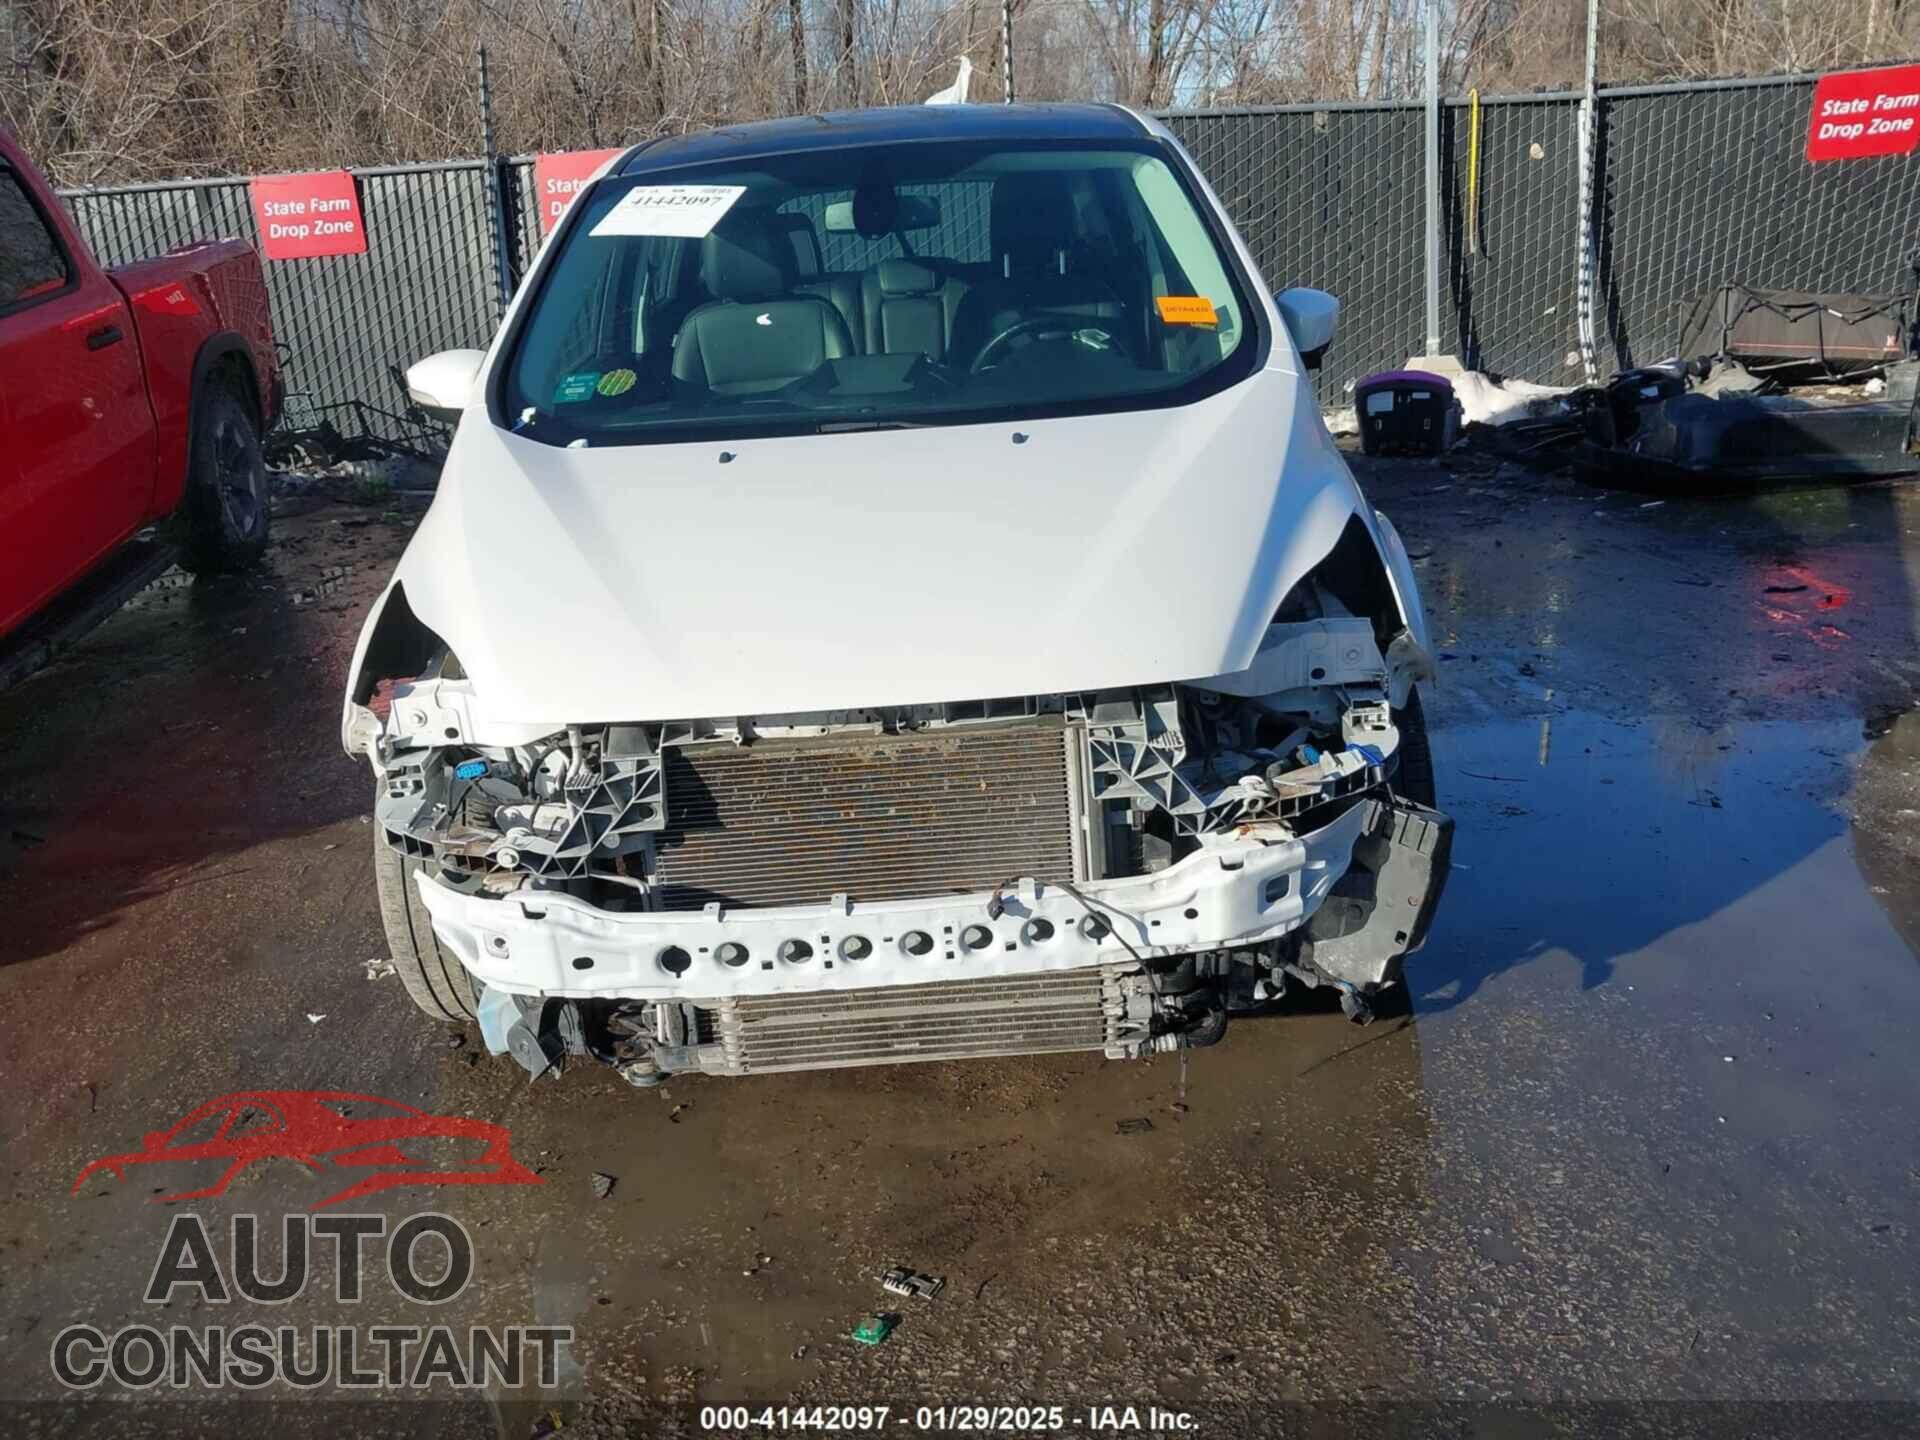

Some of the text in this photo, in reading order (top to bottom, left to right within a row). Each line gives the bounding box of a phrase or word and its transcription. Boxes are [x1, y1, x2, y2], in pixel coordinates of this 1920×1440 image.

[1821, 94, 1920, 117] State Farm
[1818, 117, 1914, 140] Drop Zone
[263, 197, 350, 217] State Farm
[632, 195, 723, 207] 41442097
[269, 220, 355, 239] Drop Zone
